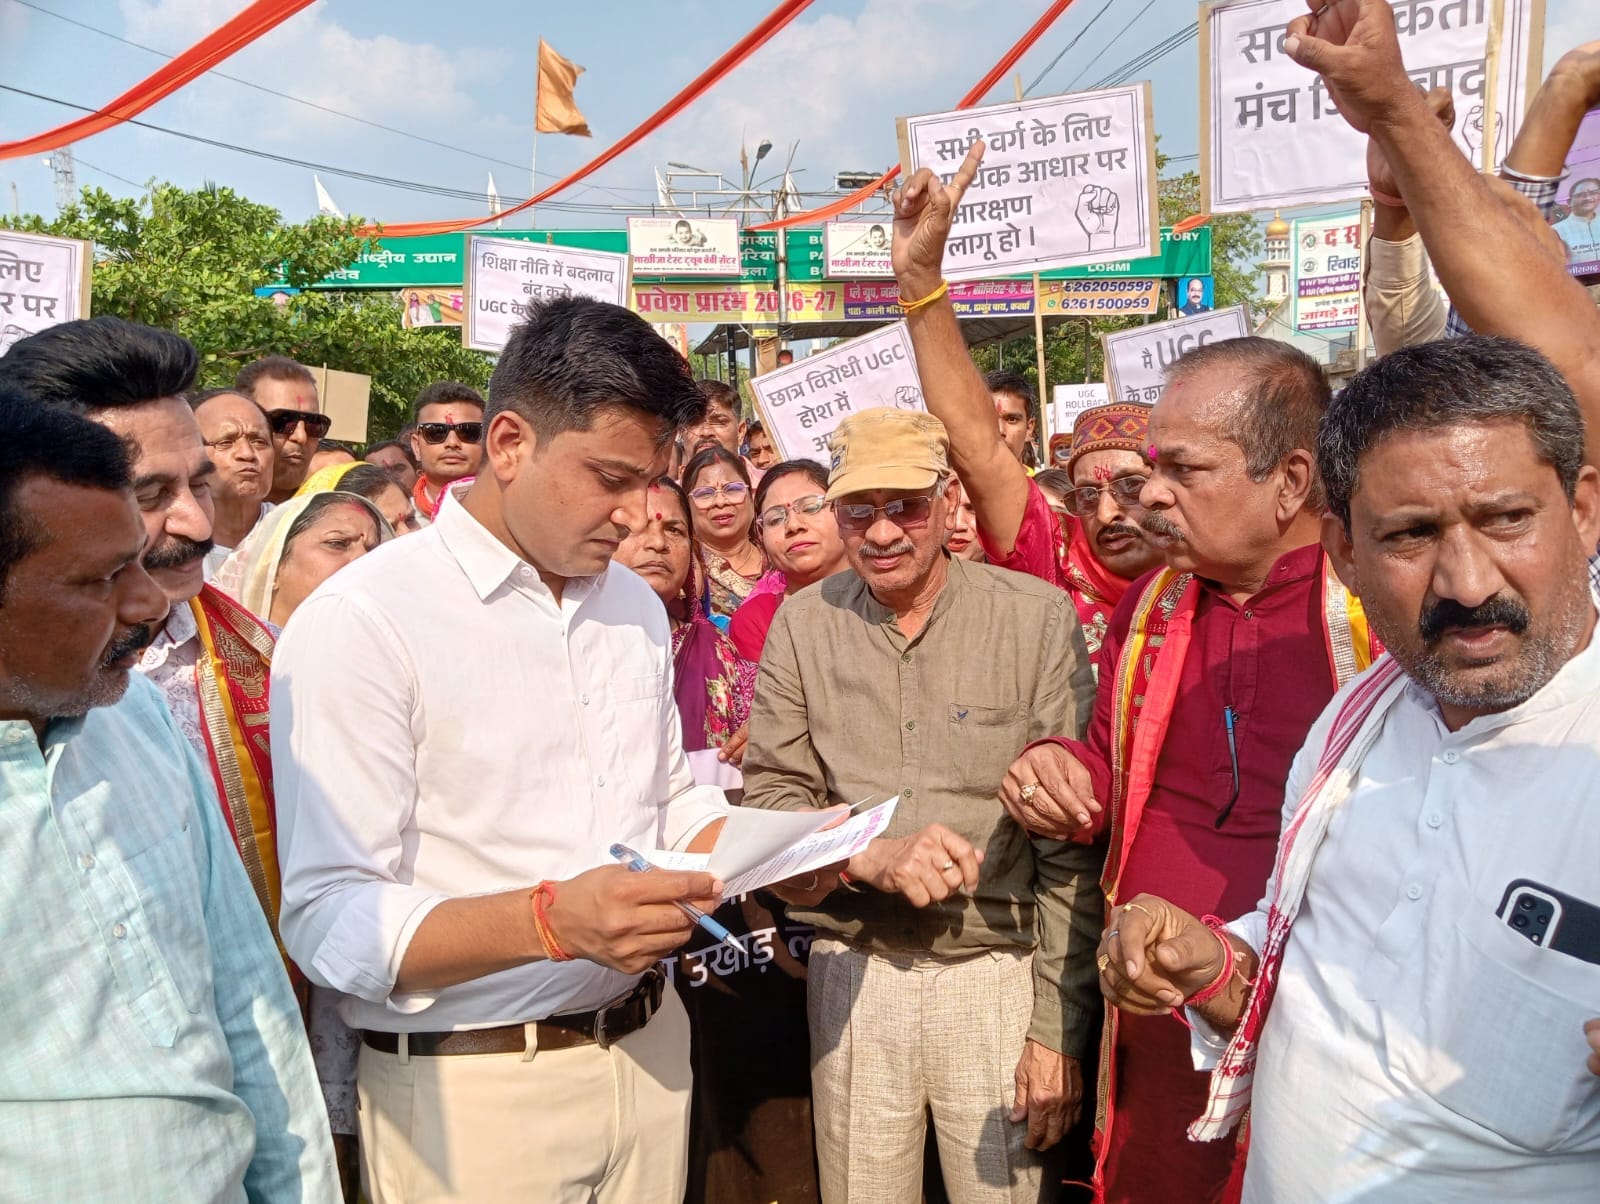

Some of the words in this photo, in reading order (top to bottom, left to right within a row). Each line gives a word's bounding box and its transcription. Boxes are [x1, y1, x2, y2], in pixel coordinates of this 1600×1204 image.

[1235, 82, 1301, 130] मंच
[988, 120, 1025, 152] वर्ग
[1031, 119, 1057, 147] के
[1062, 112, 1112, 143] लिए
[1017, 153, 1090, 183] आधार
[1095, 148, 1128, 171] पर
[413, 253, 457, 263] उद्यान
[948, 232, 997, 260] लागू
[996, 223, 1020, 252] हो
[481, 252, 517, 272] शिक्षा
[520, 257, 550, 275] नीति
[552, 260, 564, 277] में
[566, 265, 615, 283] बदलाव
[522, 280, 543, 296] बंद
[636, 287, 690, 312] प्रवेश
[695, 287, 748, 312] प्रारंभ
[21, 294, 58, 318] पर
[479, 299, 508, 314] UGC
[766, 382, 805, 407] छात्र
[805, 355, 863, 394] विरोधी
[865, 344, 905, 370] UGC
[796, 401, 834, 428] होश
[834, 391, 851, 412] में
[1078, 389, 1095, 398] UGC
[686, 927, 776, 988] उखाड़
